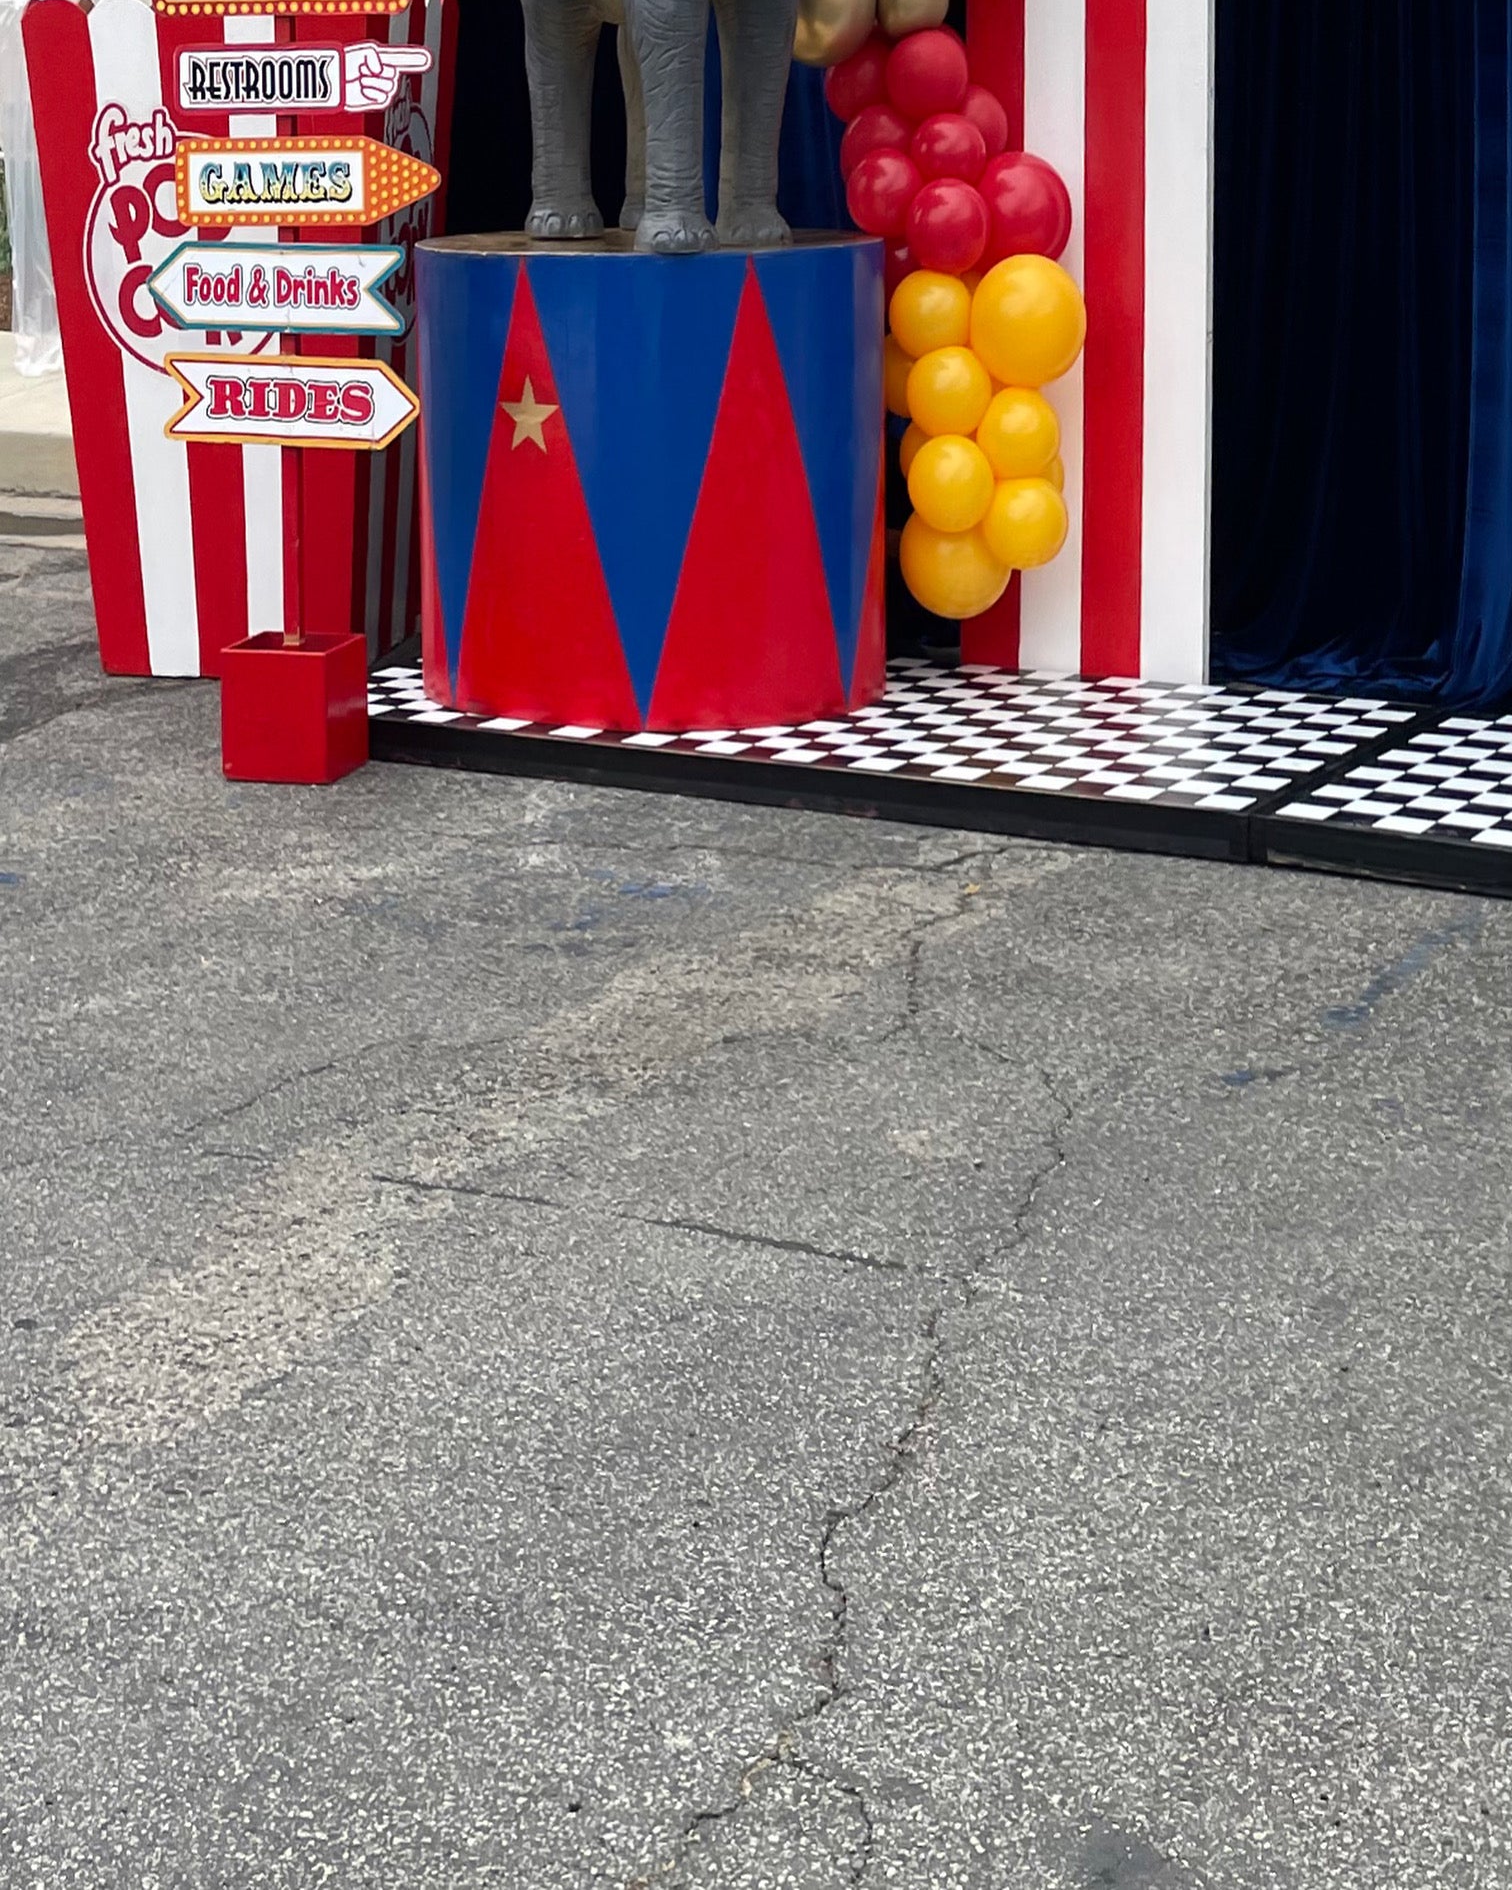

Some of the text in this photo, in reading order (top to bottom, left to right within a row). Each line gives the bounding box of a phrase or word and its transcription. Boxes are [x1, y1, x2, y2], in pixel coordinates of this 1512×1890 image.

[186, 57, 332, 102] RESTROOMS
[96, 105, 176, 185] fresh
[199, 161, 353, 205] GAMES
[185, 264, 242, 306] Food
[247, 267, 269, 307] &
[274, 266, 360, 308] Drinks
[207, 377, 374, 424] RIDES
